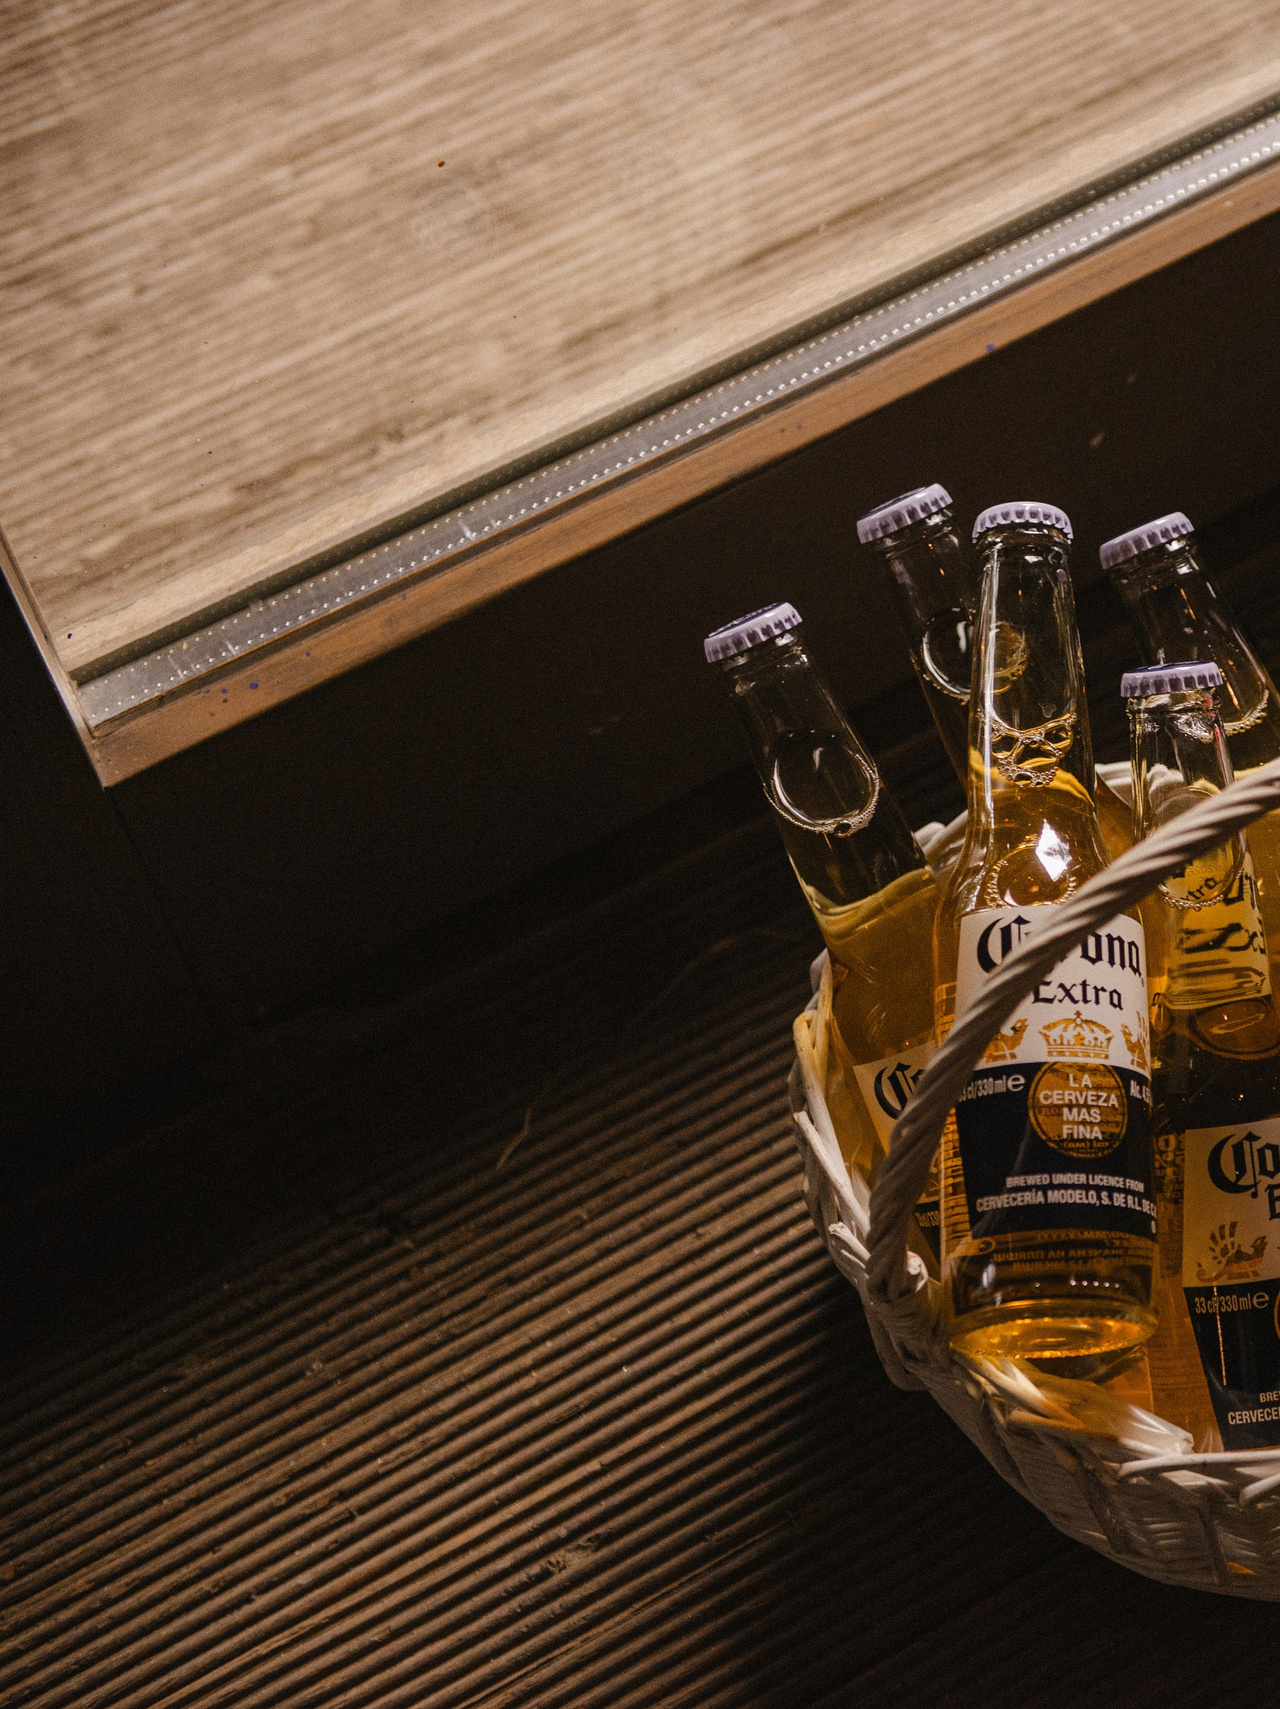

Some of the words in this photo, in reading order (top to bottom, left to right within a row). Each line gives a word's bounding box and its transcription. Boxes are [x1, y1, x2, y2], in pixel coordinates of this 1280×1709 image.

[976, 914, 1142, 979] Cona
[1032, 979, 1124, 1011] Extra
[1069, 1074, 1092, 1088] LA
[1039, 1090, 1119, 1108] CERVEZA
[1062, 1107, 1101, 1123] MAS
[1062, 1125, 1103, 1140] FINA
[1006, 1174, 1049, 1188] BREWED
[1052, 1173, 1087, 1185] UNDER
[1088, 1174, 1125, 1188] LICENCE
[1126, 1178, 1144, 1193] FROM
[1048, 1190, 1100, 1206] MODELO,
[1101, 1191, 1112, 1205] S.
[1113, 1192, 1126, 1207] DE
[1195, 1297, 1207, 1314] 33
